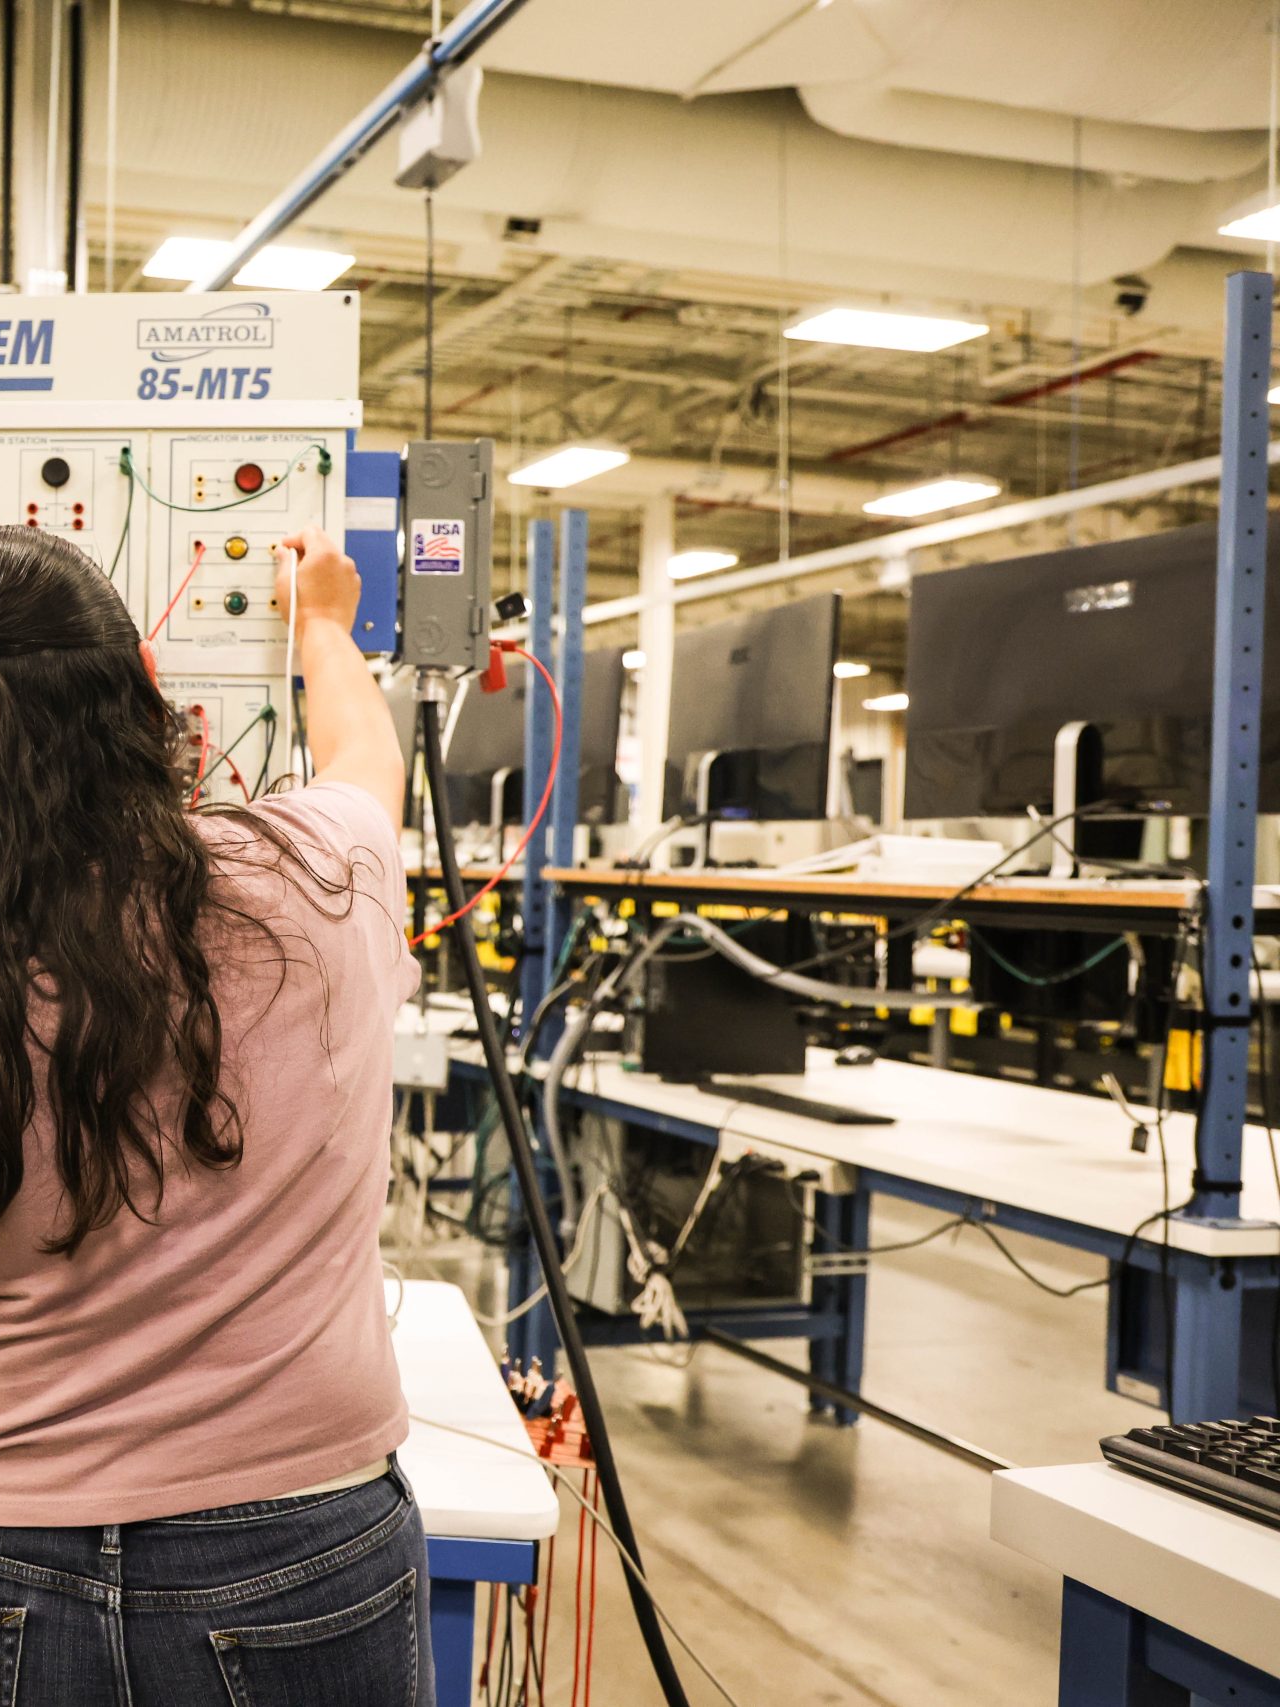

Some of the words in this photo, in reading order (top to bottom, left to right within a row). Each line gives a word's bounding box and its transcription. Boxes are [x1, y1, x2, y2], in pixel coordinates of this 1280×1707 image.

[145, 324, 267, 343] AMATROL
[137, 367, 272, 400] 85-MT5
[7, 436, 48, 445] STATION
[187, 433, 239, 443] INDICATOR
[241, 433, 269, 443] LAMP
[272, 433, 312, 442] STATION
[431, 523, 460, 536] USA
[179, 681, 219, 689] STATION
